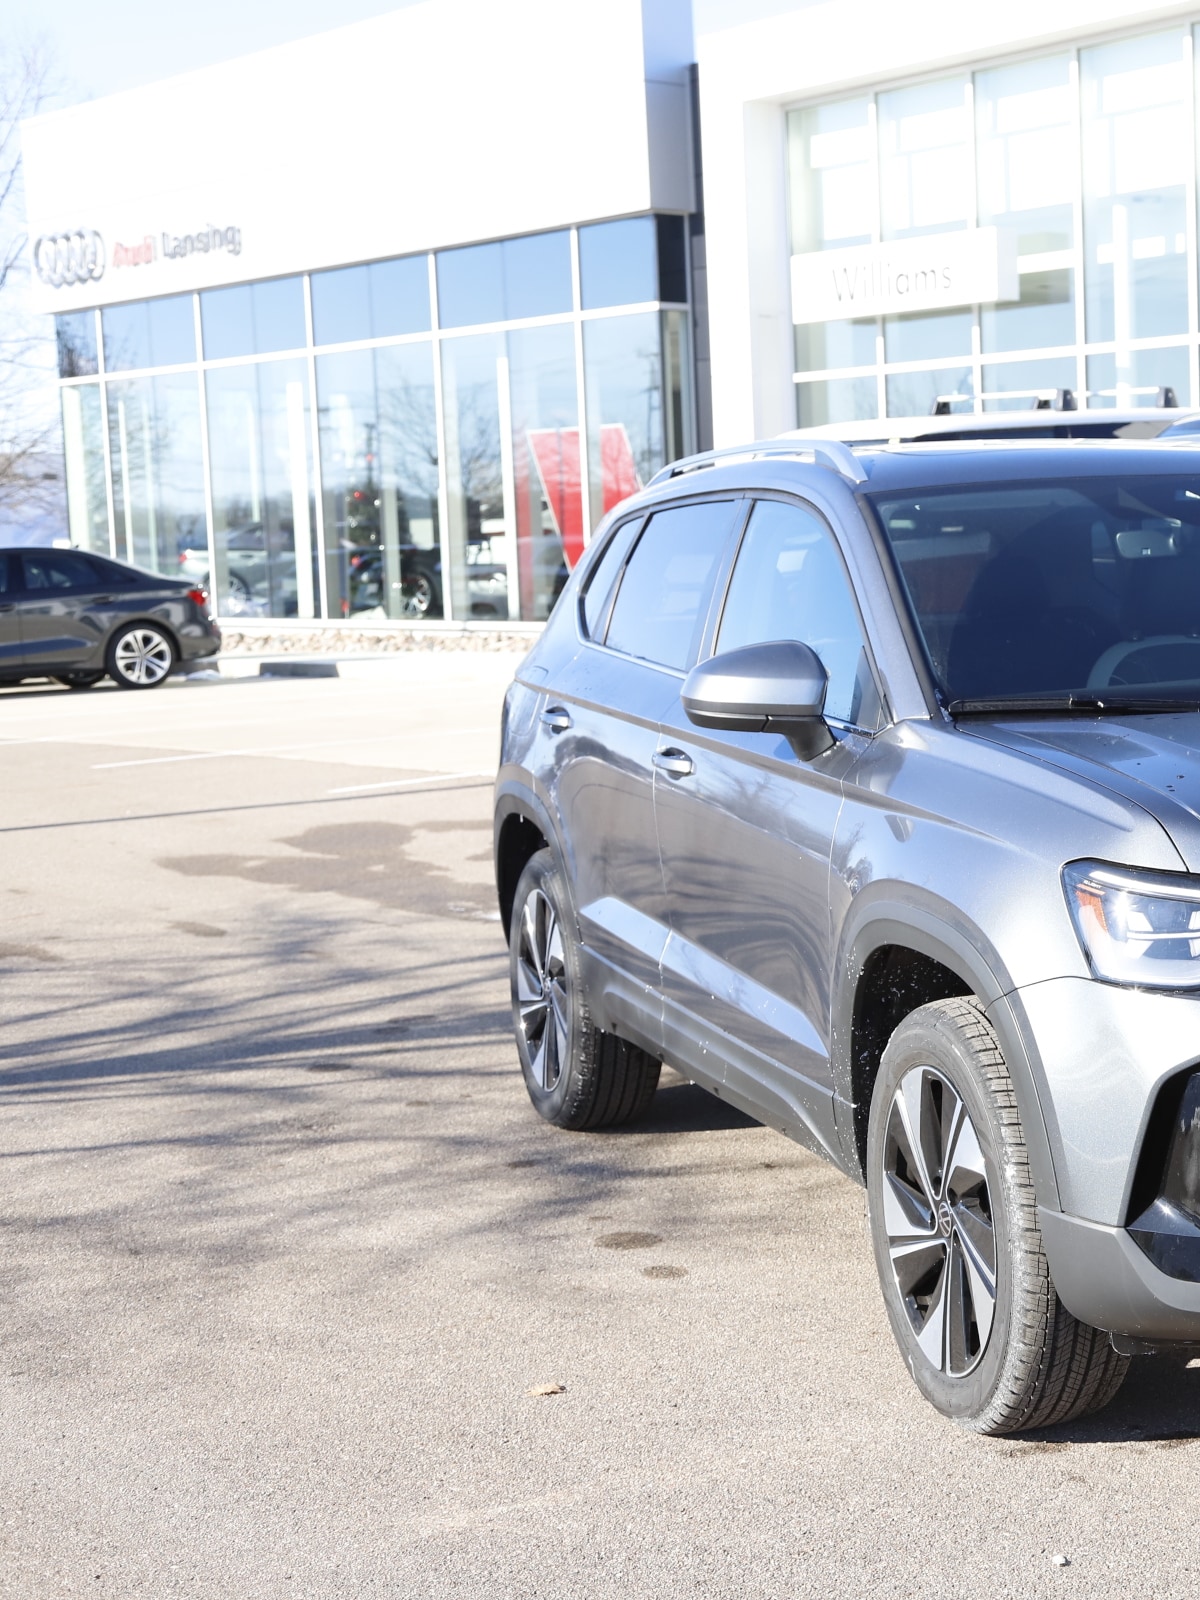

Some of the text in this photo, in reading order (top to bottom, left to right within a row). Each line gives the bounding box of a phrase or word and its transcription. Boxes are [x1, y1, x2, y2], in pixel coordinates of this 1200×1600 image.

[112, 222, 242, 268] Audi Lansing
[831, 260, 952, 302] Williams
